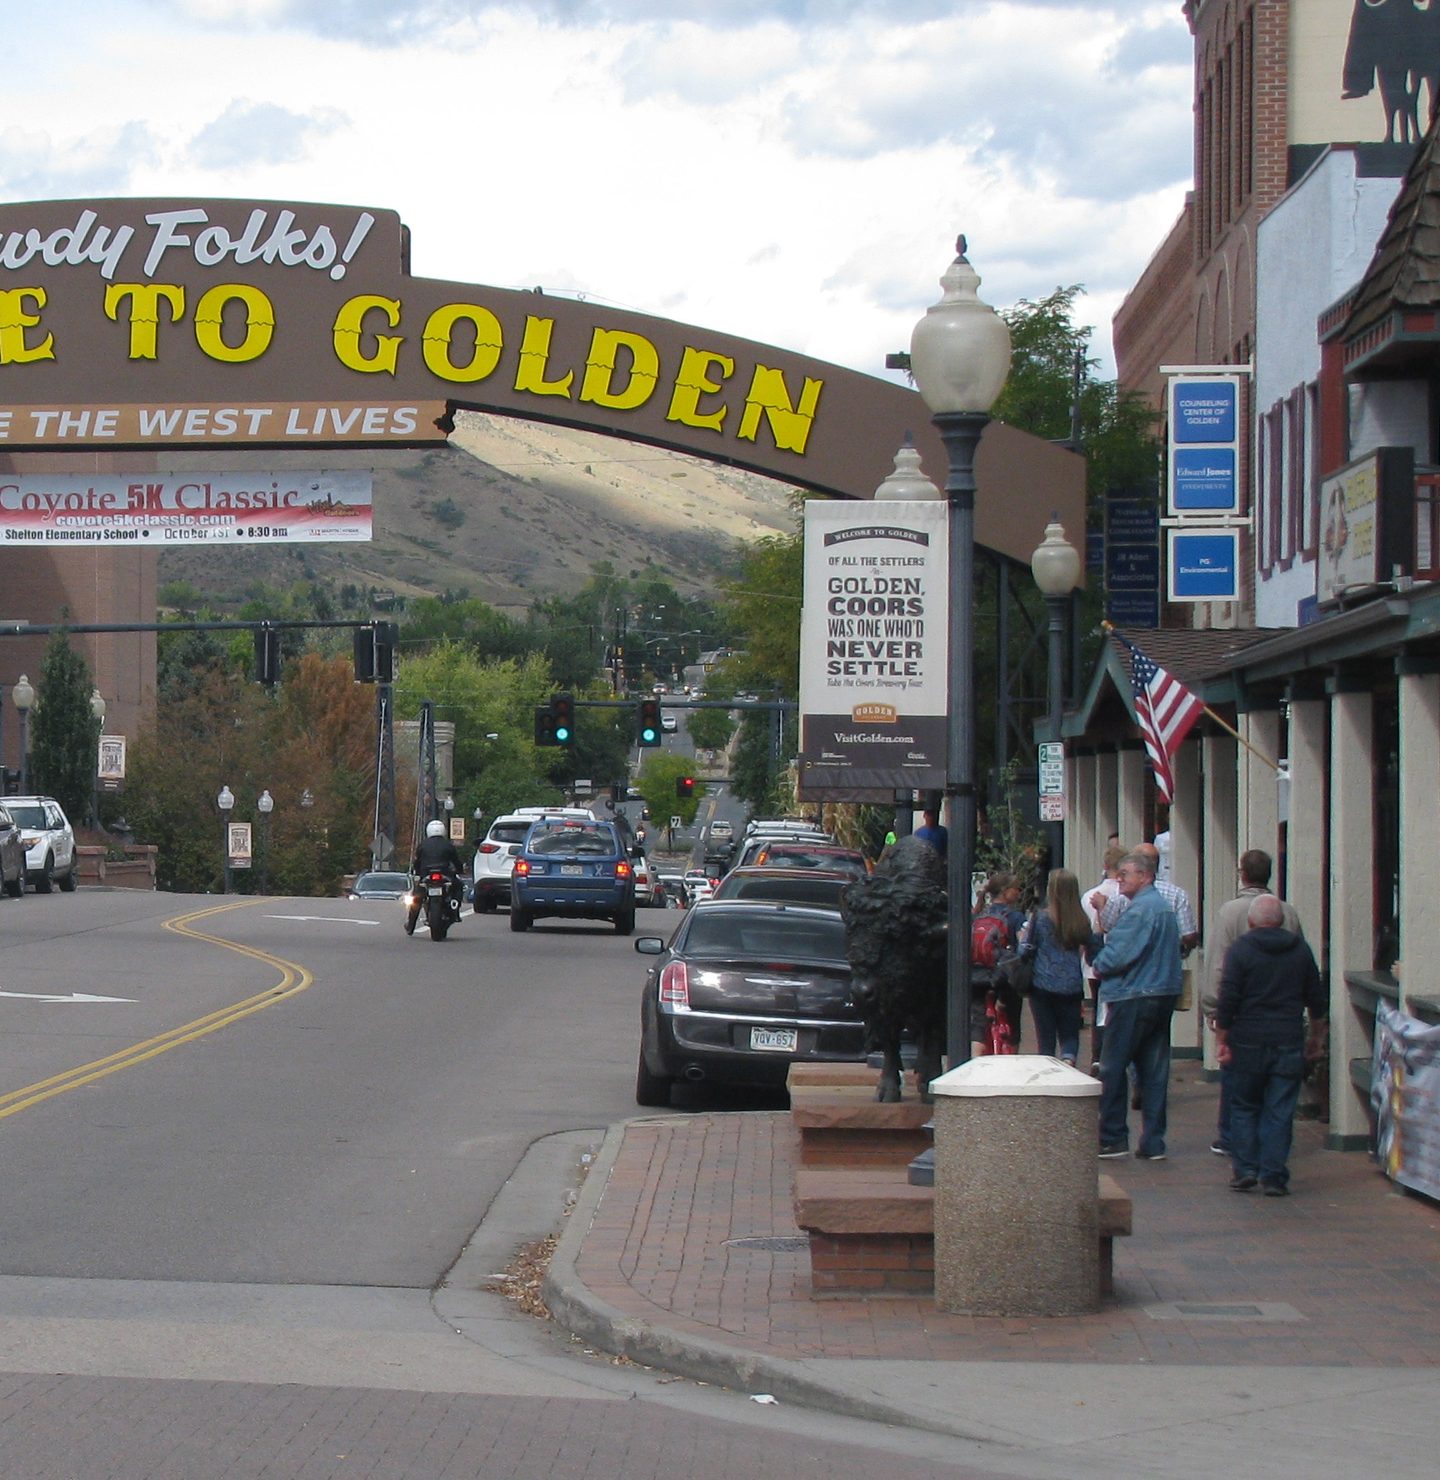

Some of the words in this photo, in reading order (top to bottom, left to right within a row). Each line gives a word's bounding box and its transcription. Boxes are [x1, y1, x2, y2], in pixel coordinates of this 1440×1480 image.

[145, 208, 377, 281] Folks!
[104, 283, 275, 363] TO
[333, 295, 824, 455] GOLDEN
[30, 410, 119, 438] THE
[139, 408, 272, 436] WEST
[284, 407, 418, 435] LIVES
[1177, 468, 1205, 476] Edward
[1206, 468, 1232, 476] Jones
[127, 484, 164, 511] 5K
[175, 482, 298, 510] Classic
[55, 513, 236, 527] coyote5kclassic.com
[5, 529, 43, 540] Shelton
[45, 528, 100, 541] Elementary
[103, 528, 138, 540] School
[164, 528, 208, 539] October
[248, 526, 270, 538] 8:30
[272, 527, 288, 537] am
[834, 529, 871, 541] WELCOME
[888, 529, 918, 540] GOLDEN
[828, 557, 840, 566] OF
[841, 557, 858, 566] ALL
[860, 557, 878, 566] THE
[880, 557, 925, 566] SETTLERS
[827, 577, 926, 596] GOLDEN,
[827, 596, 924, 617] COORS
[827, 619, 854, 637] WAS
[857, 619, 881, 638] ONE
[884, 619, 924, 638] WHO'D
[827, 641, 923, 658] NEVER
[827, 660, 923, 676] SETTLE.
[827, 678, 841, 687] Take
[855, 679, 875, 687] Coors
[855, 706, 892, 716] GOLDEN
[834, 733, 915, 743] VisitGolden.com
